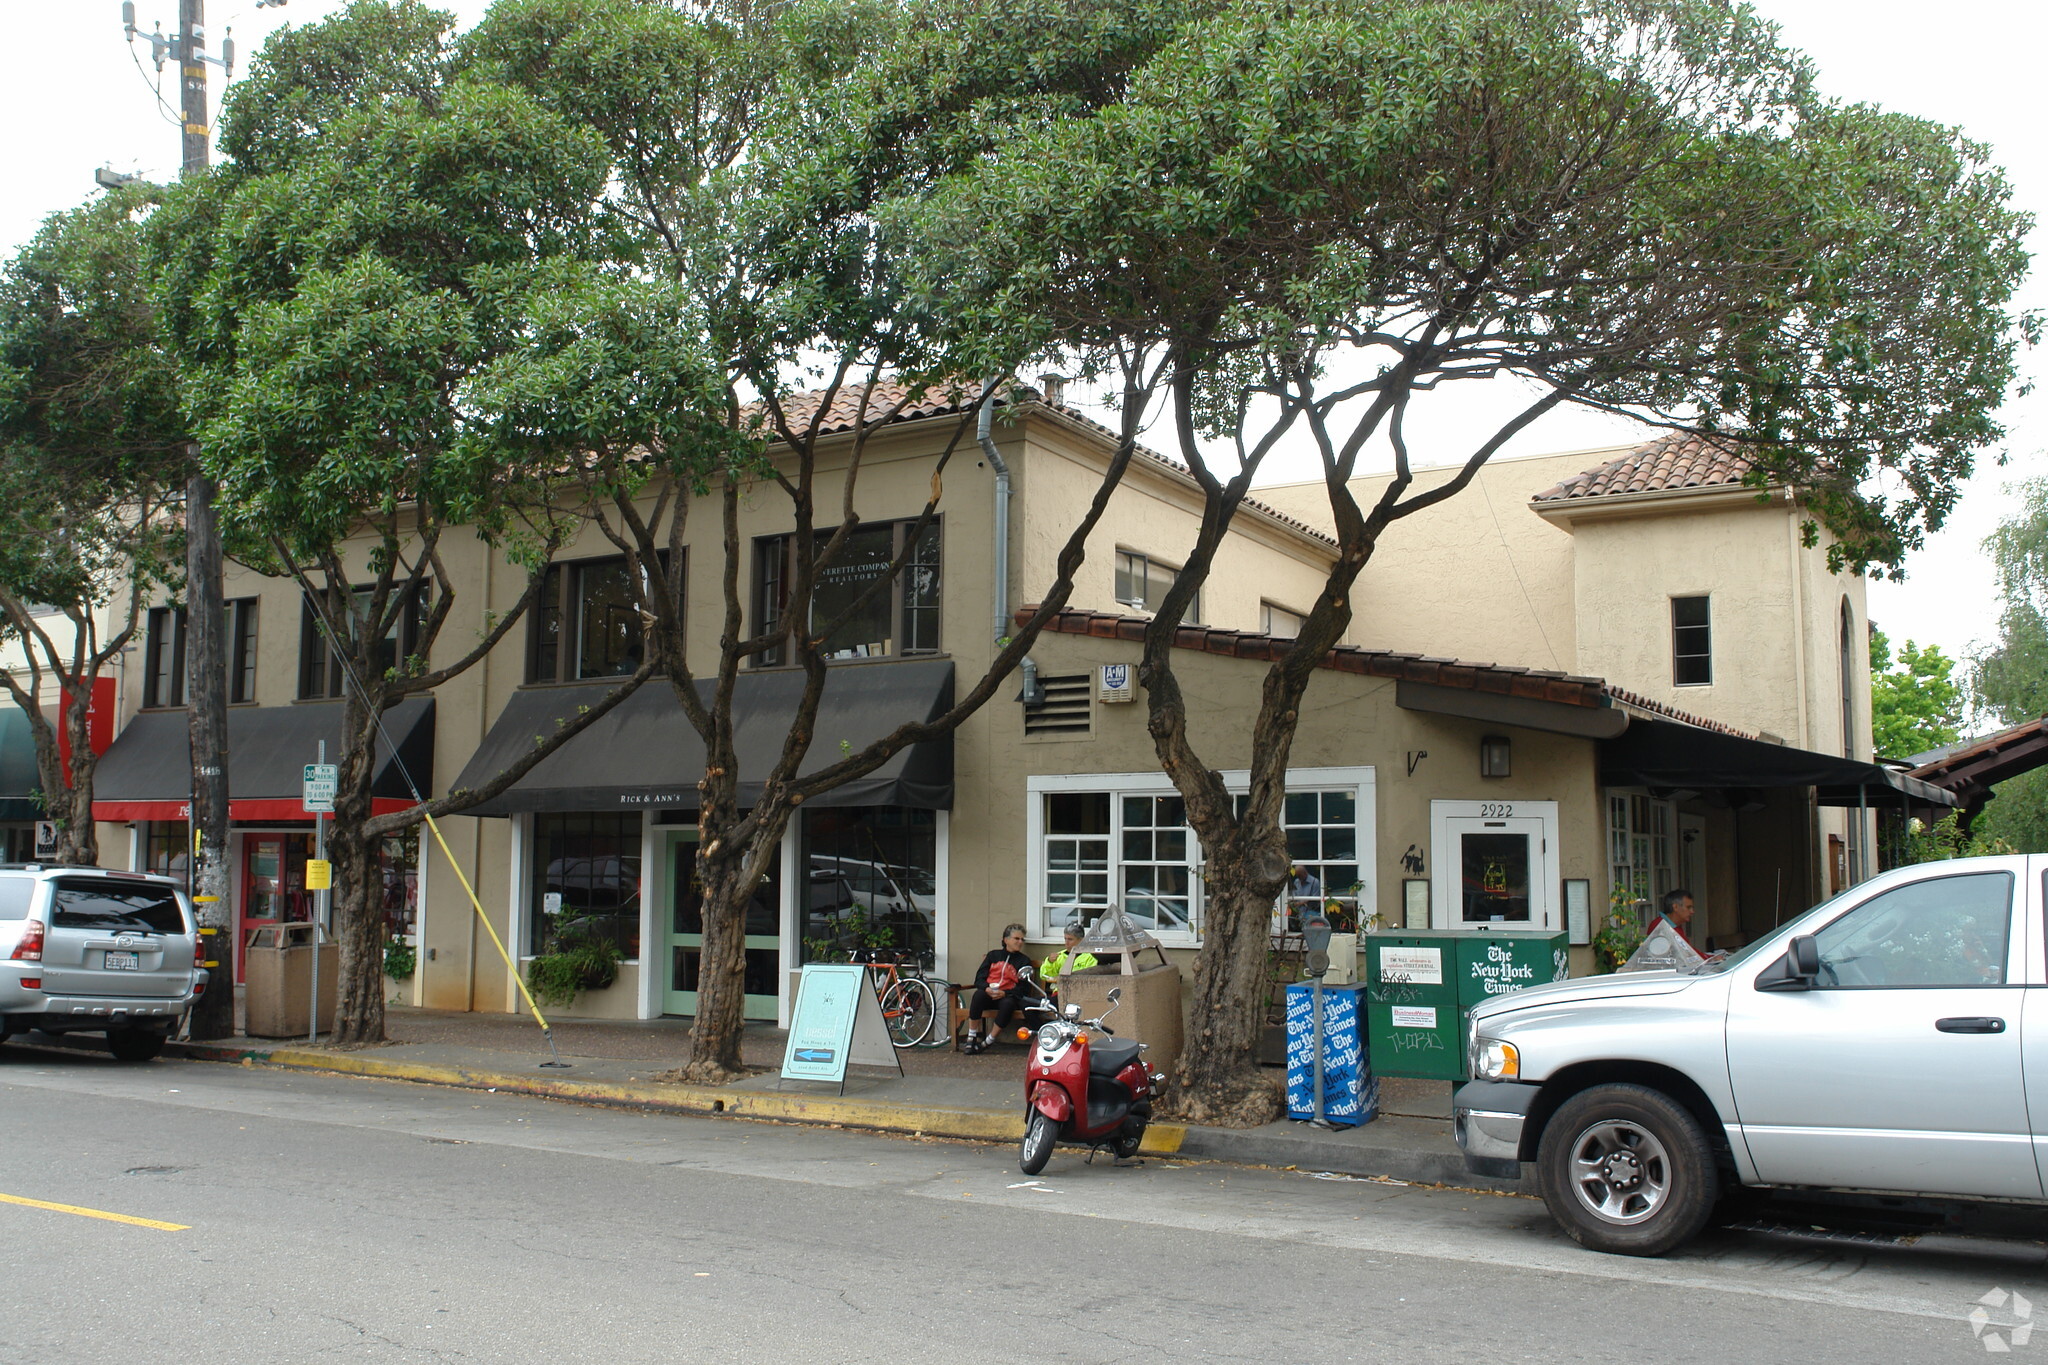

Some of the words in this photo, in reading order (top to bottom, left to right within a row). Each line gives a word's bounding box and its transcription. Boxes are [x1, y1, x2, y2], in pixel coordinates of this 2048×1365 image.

[857, 561, 890, 573] COMPAN
[829, 573, 877, 583] REALTORS
[306, 769, 315, 779] 30
[643, 794, 651, 803] &
[1481, 804, 1513, 818] 2922
[1488, 945, 1513, 963] The
[1471, 962, 1500, 979] New
[1500, 961, 1533, 983] York
[1287, 1001, 1312, 1020] imes
[1326, 998, 1353, 1021] York
[1324, 1016, 1356, 1035] Times
[1331, 1034, 1354, 1049] The
